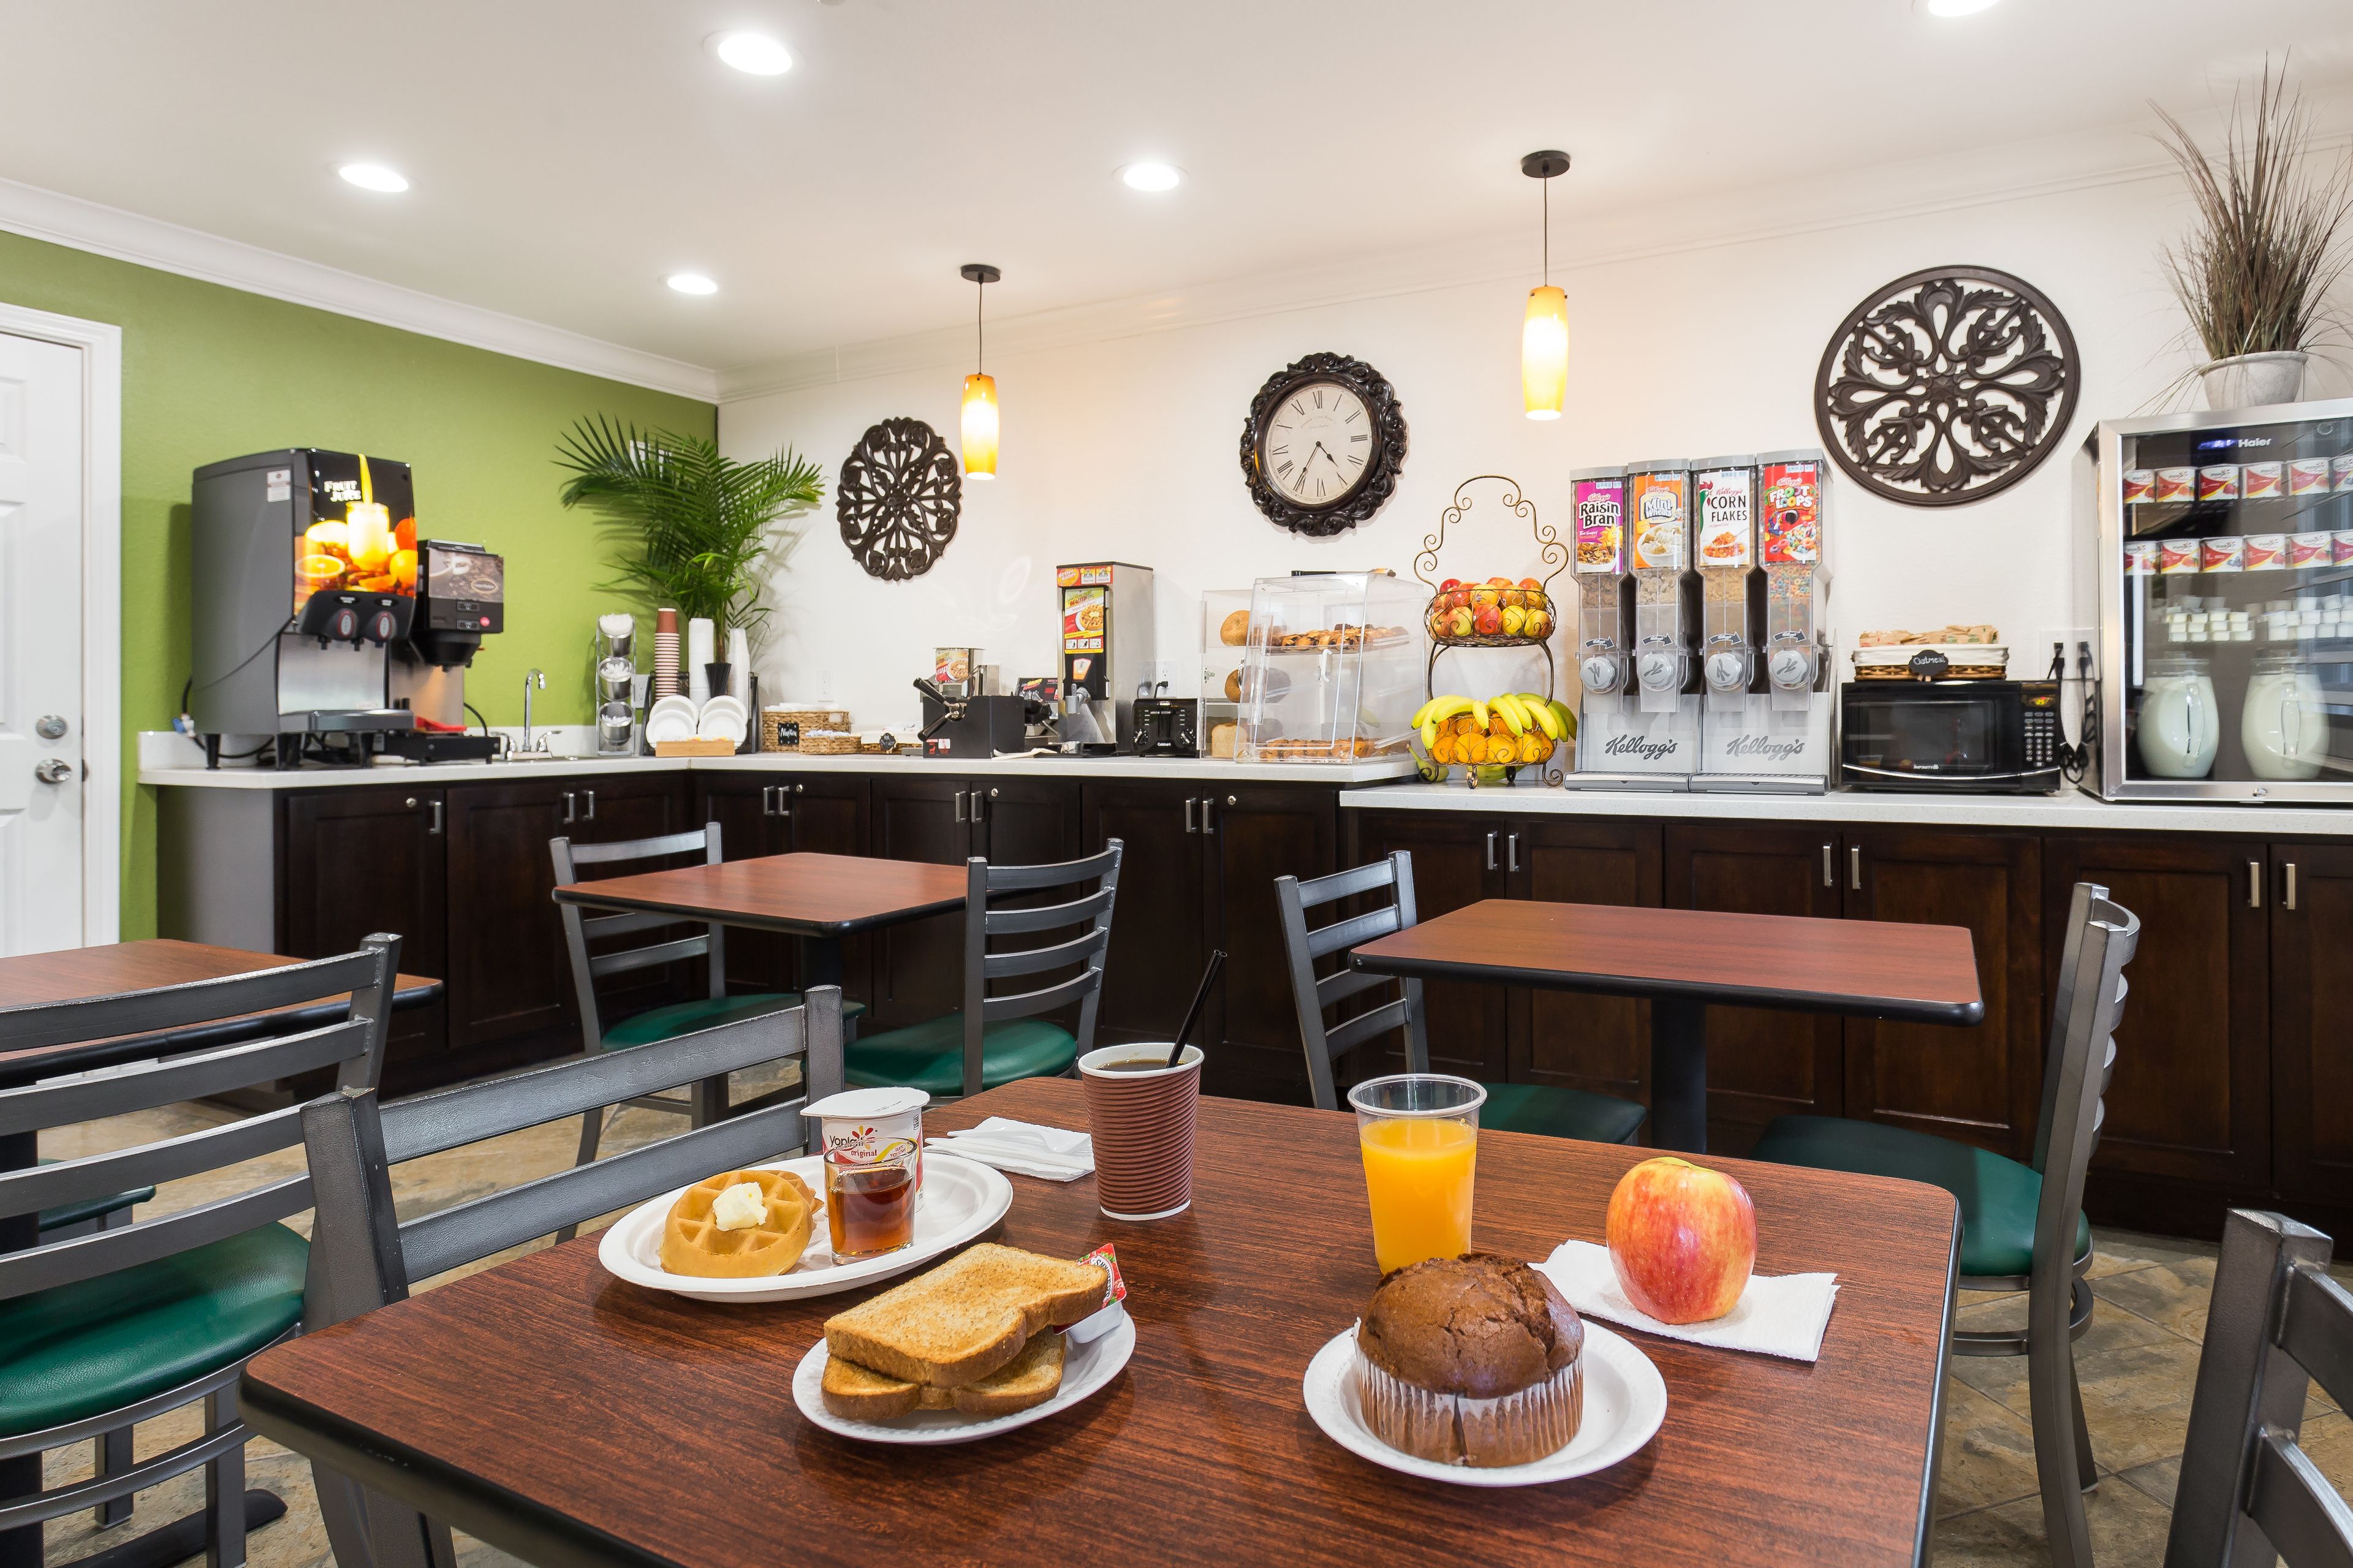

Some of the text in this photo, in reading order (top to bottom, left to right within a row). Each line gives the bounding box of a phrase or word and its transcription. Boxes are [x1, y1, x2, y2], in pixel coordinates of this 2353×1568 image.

[2238, 437, 2272, 448] Haier
[1769, 485, 1810, 502] FROOT
[1711, 495, 1746, 509] CORN
[1775, 496, 1814, 509] LOOPS
[1580, 502, 1620, 517] Raisin
[1711, 510, 1748, 523] FLAKES
[1584, 513, 1616, 528] Bran
[1913, 655, 1946, 665] Oatmeal
[1605, 734, 1678, 760] Kellogg's
[1727, 734, 1805, 761] Kellogg's
[851, 1149, 878, 1159] original
